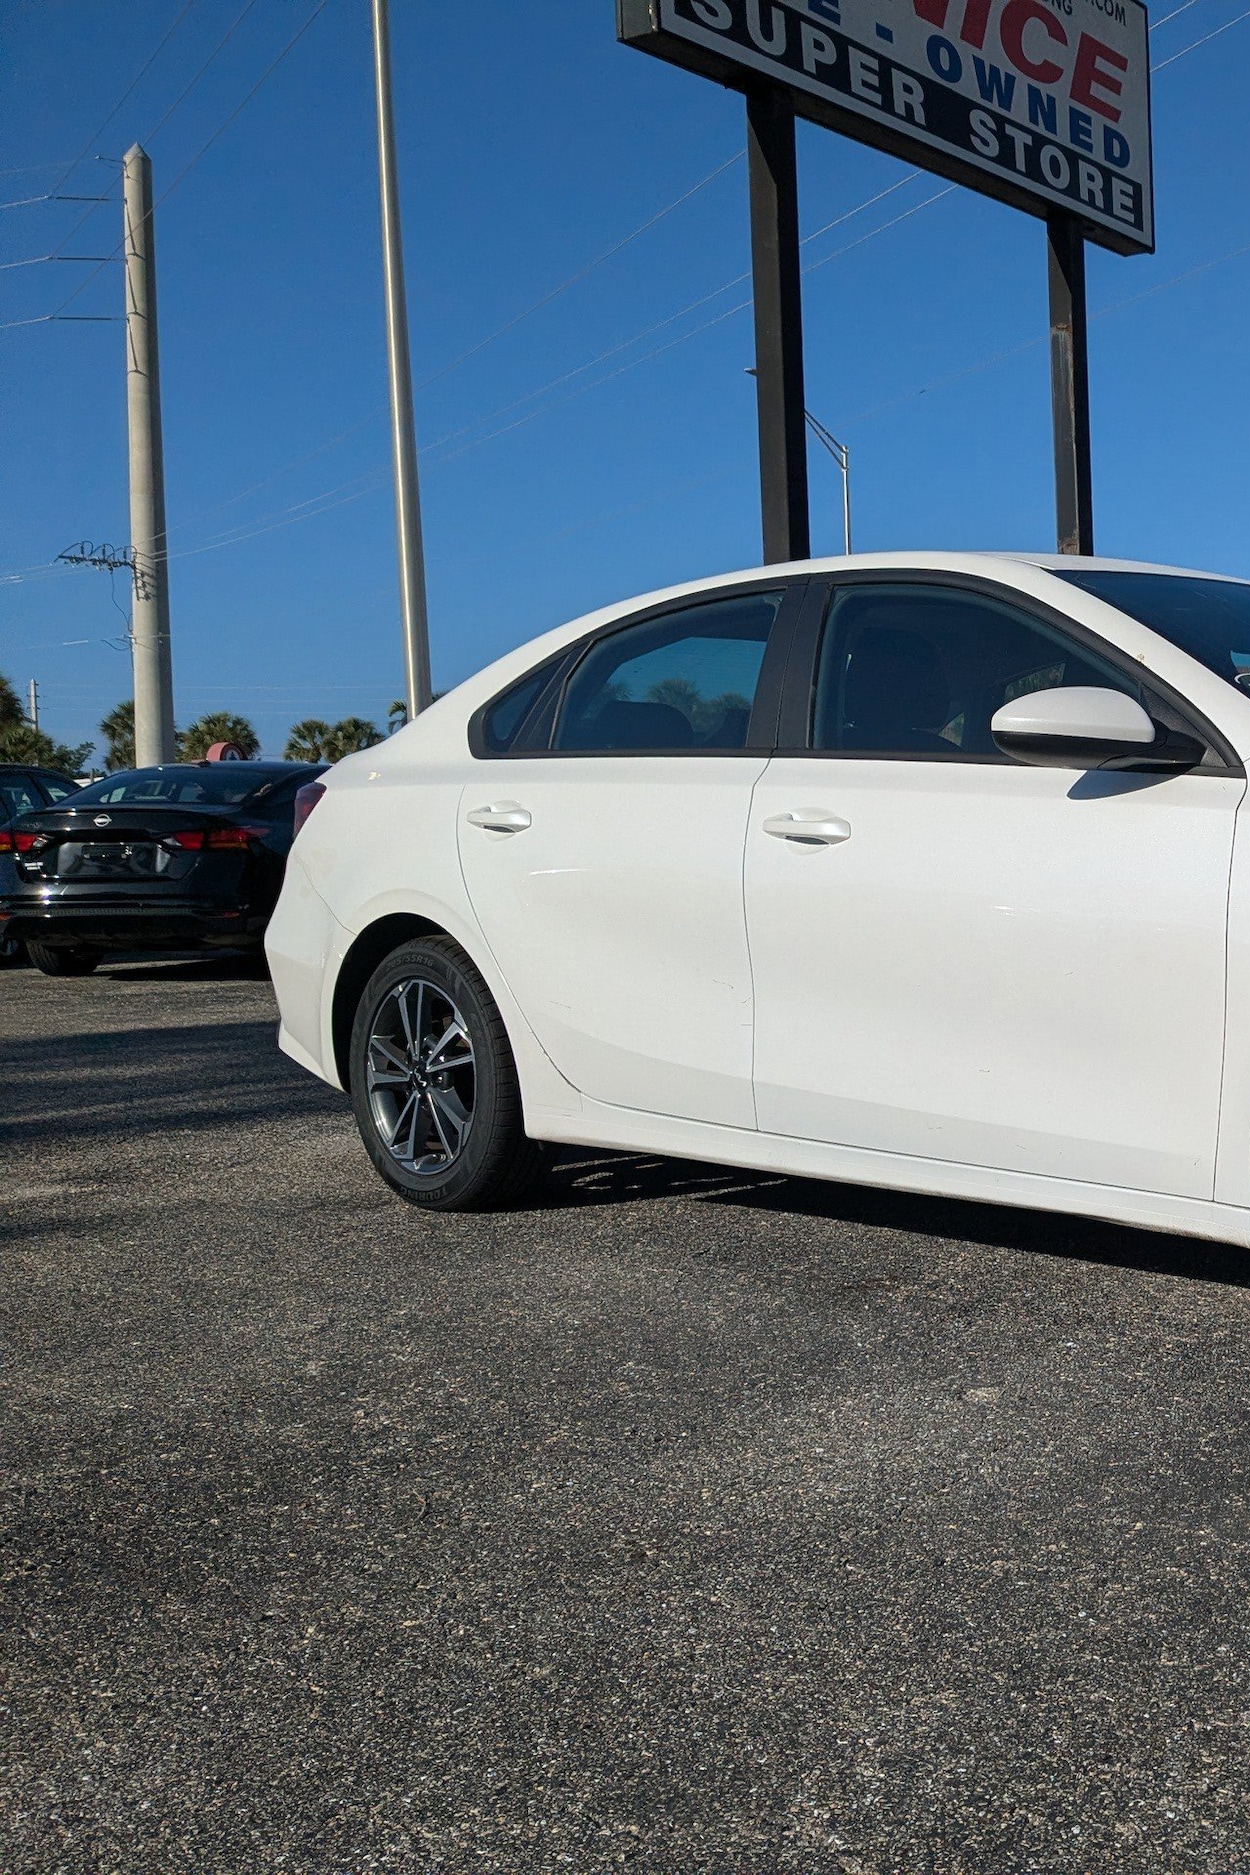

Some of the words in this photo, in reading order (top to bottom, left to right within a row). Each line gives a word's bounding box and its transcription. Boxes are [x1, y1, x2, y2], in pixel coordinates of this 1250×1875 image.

[691, 0, 926, 126] SUPER
[969, 109, 1136, 224] STORE
[926, 34, 1131, 169] OWNED
